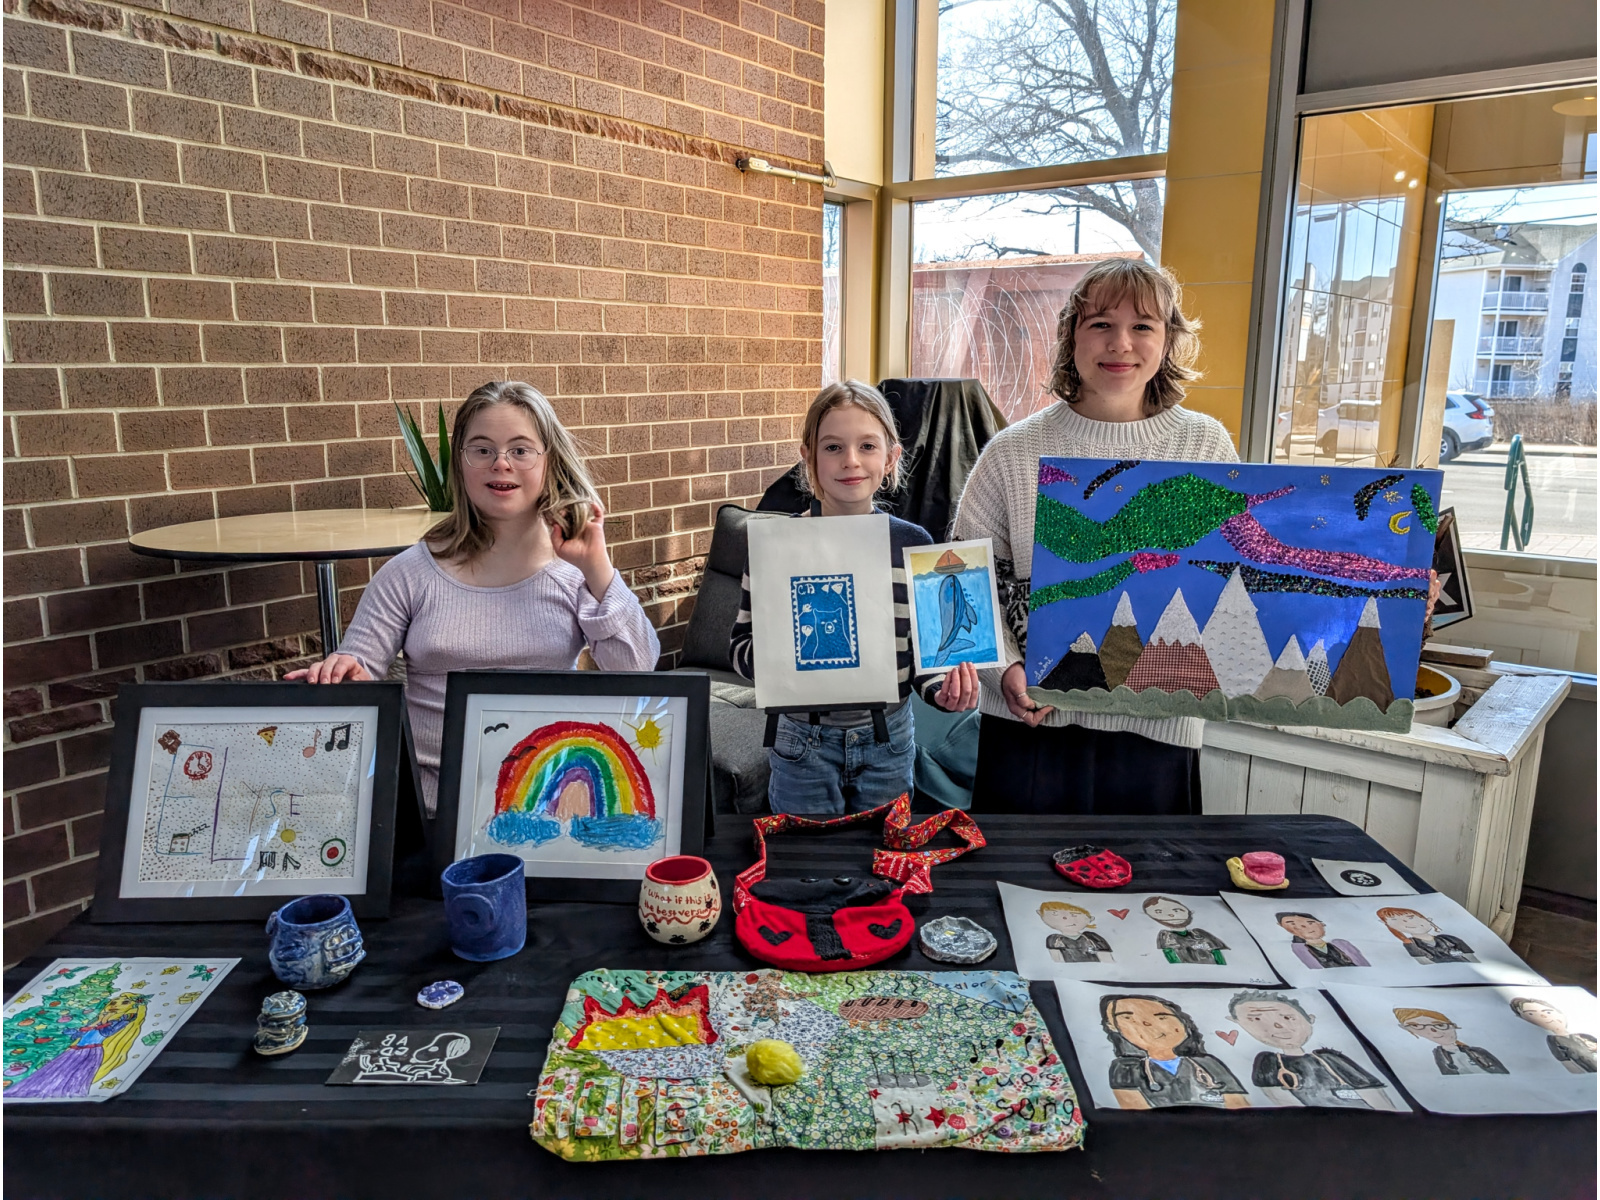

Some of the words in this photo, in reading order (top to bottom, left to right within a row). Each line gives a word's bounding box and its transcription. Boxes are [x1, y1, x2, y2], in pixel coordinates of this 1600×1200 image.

[674, 894, 684, 905] if
[685, 895, 703, 905] this
[643, 899, 655, 913] the
[656, 904, 677, 918] best
